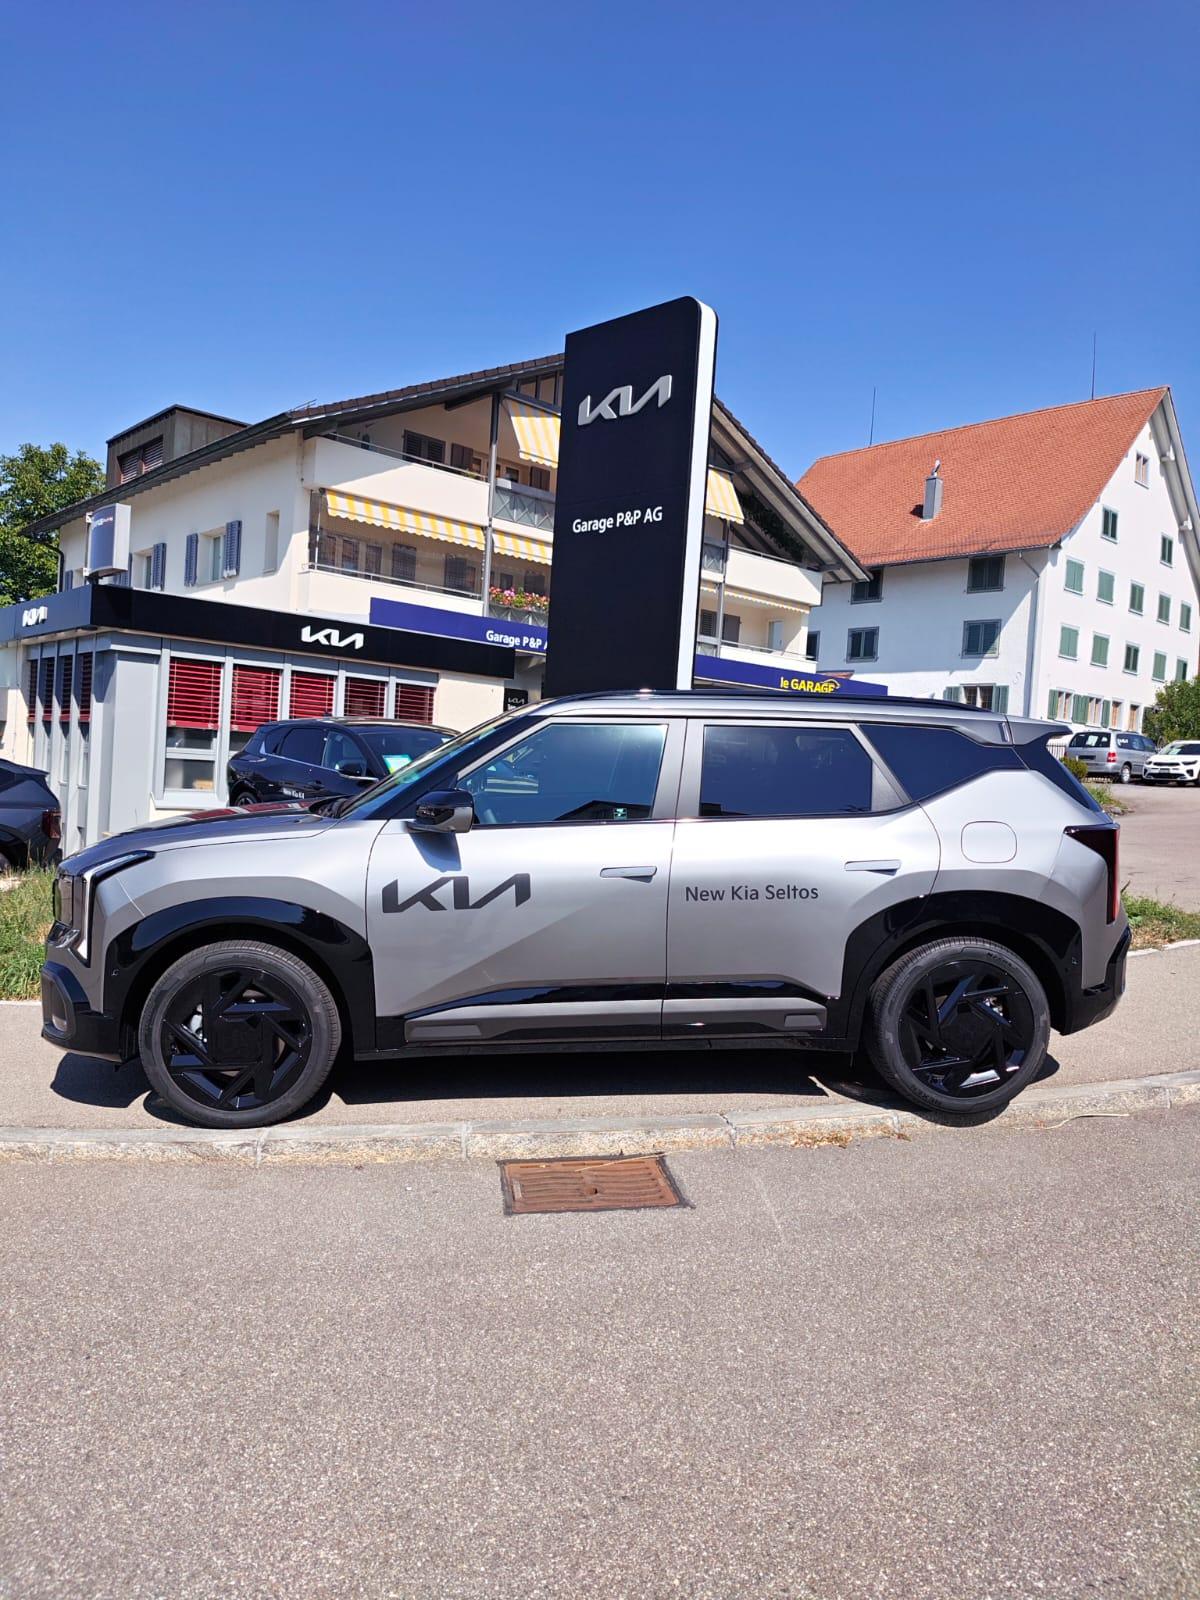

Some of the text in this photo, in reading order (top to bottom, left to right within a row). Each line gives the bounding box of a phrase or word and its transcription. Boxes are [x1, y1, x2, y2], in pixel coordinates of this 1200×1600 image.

[577, 374, 673, 426] KIA
[572, 506, 663, 533] Garage P&P AG
[301, 625, 364, 649] KIA
[486, 630, 520, 648] Garage
[522, 636, 542, 648] P&P
[780, 676, 835, 693] le GARAGE
[381, 873, 531, 914] KIA
[685, 884, 819, 901] New Kia Seltos
